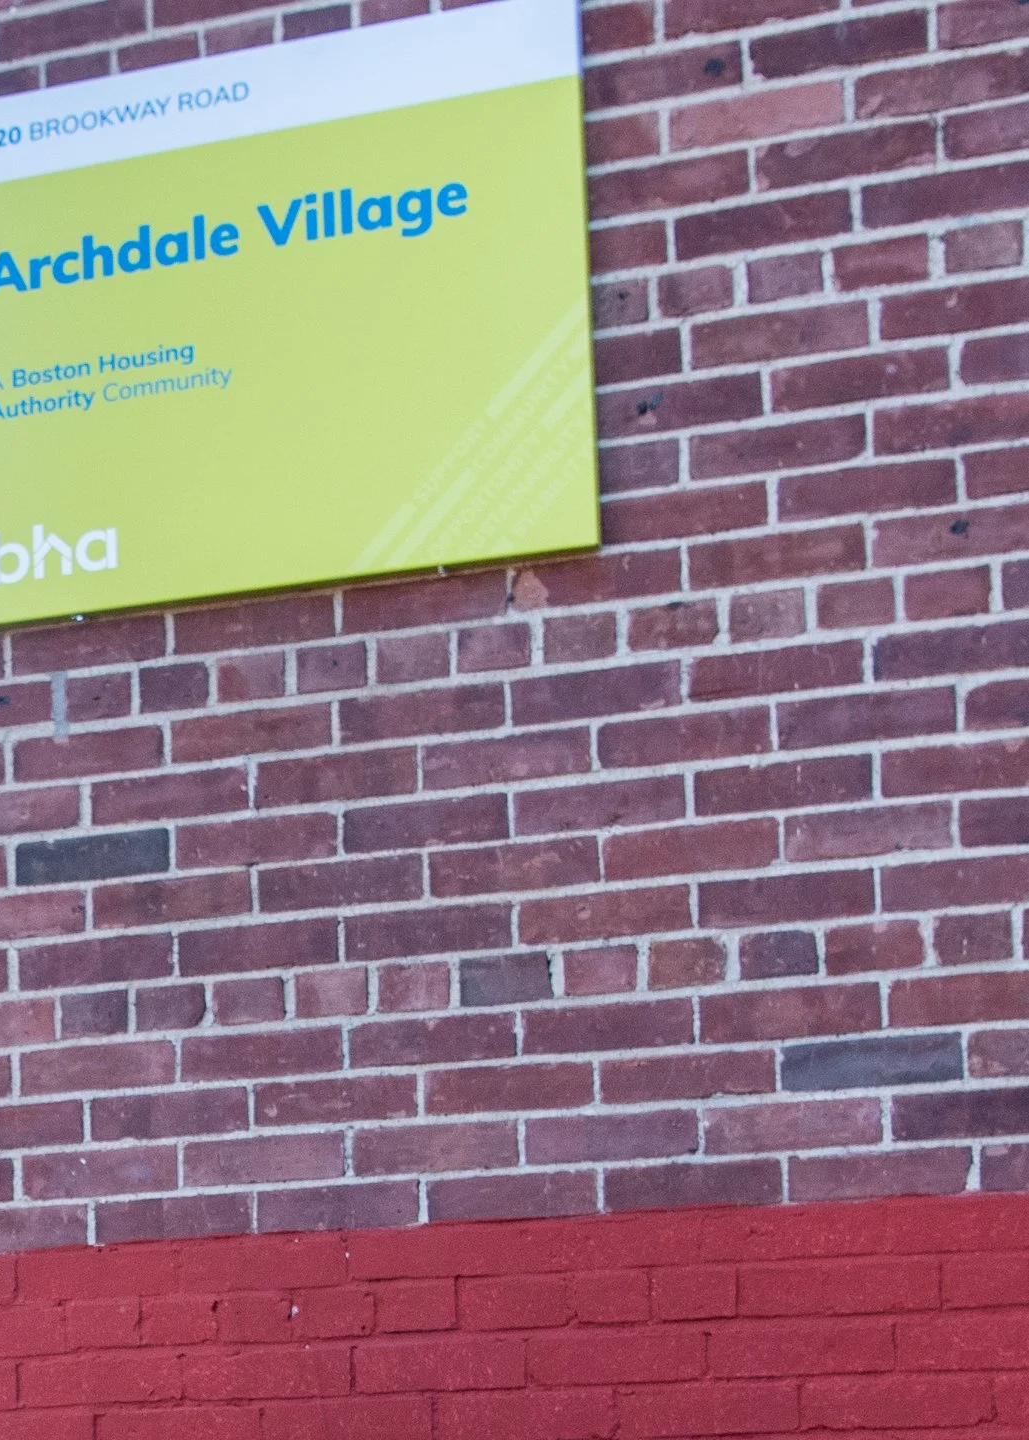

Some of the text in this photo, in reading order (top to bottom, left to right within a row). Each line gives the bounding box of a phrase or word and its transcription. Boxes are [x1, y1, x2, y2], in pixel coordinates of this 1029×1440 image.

[29, 97, 171, 141] BROOKWAY
[178, 81, 250, 113] ROAD
[257, 182, 468, 246] Village
[12, 361, 91, 388] Boston
[99, 344, 195, 373] Housing
[103, 367, 232, 402] Community
